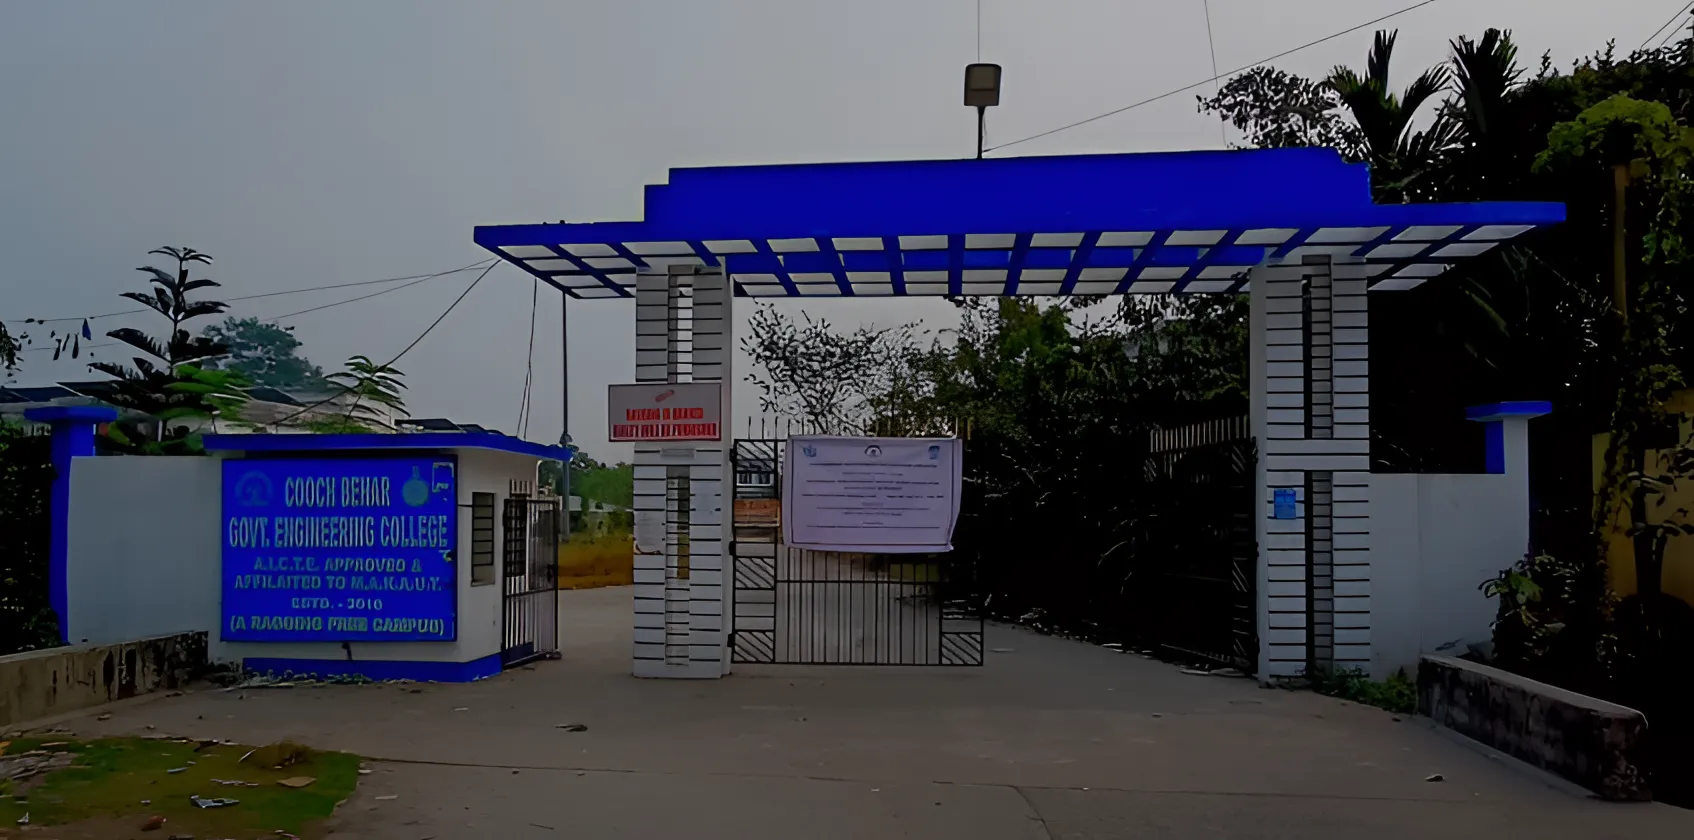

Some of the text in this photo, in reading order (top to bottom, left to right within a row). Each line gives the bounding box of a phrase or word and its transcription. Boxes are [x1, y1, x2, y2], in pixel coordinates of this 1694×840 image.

[285, 476, 391, 508] COOCH BEHAR
[229, 515, 448, 548] GOVT. ENGINEERING COLLEGE
[324, 557, 406, 573] APPROVED
[326, 576, 346, 589] TO
[230, 615, 444, 636] (A RAGGING FREE CAMPUS)
